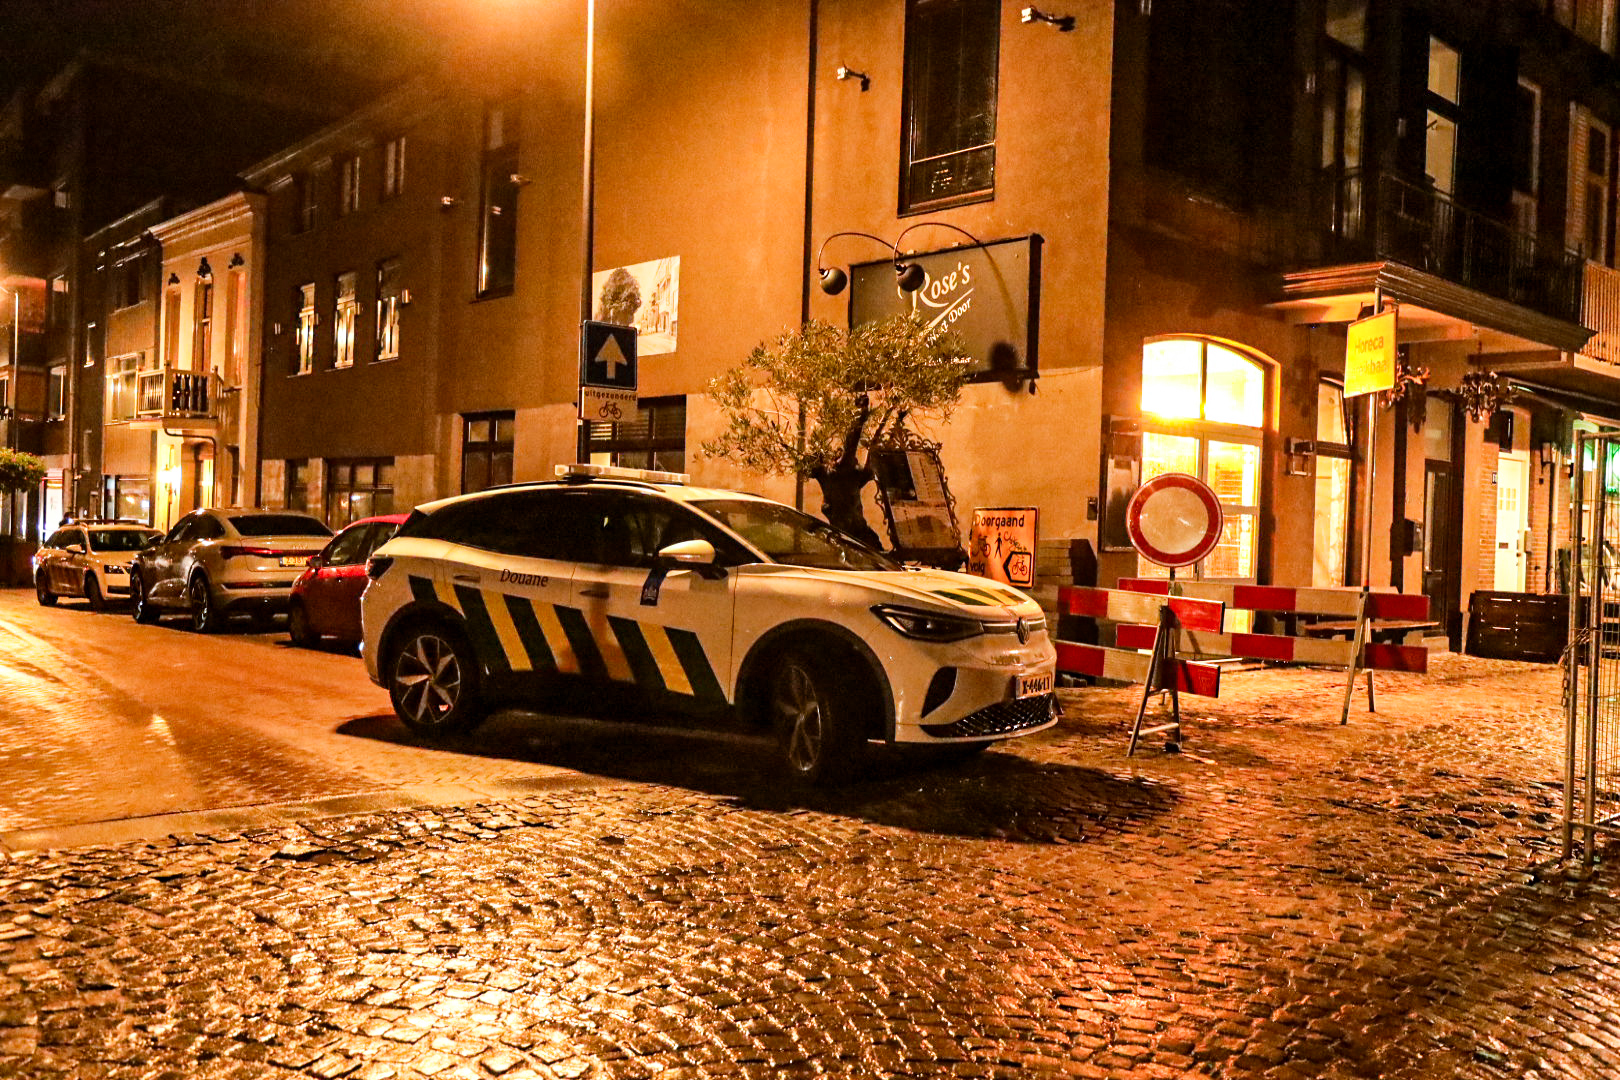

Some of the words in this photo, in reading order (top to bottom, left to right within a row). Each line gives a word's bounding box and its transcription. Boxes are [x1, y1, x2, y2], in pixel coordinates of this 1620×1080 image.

[897, 261, 971, 318] Rose's
[948, 297, 972, 324] Door
[1354, 335, 1384, 355] Horeca
[973, 513, 1025, 531] Doorgaand
[500, 568, 549, 588] Douane
